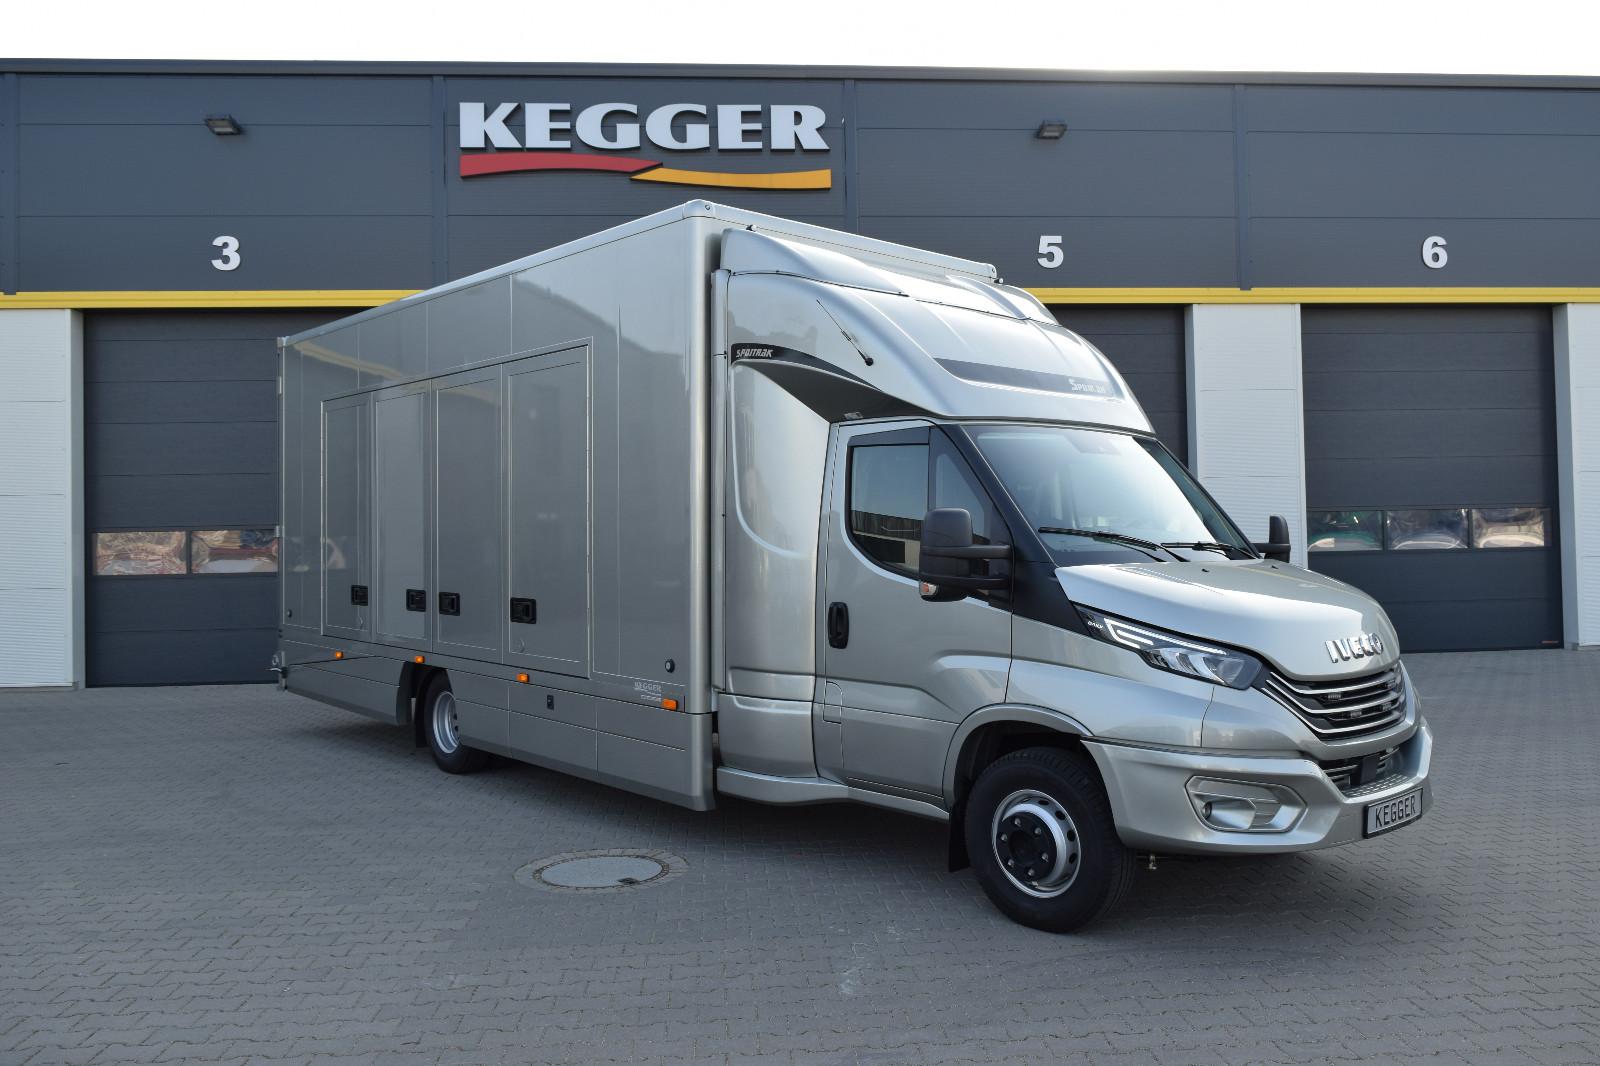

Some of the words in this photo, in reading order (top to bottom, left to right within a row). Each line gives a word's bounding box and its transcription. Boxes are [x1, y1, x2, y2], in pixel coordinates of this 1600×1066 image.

[459, 101, 830, 151] KEGGER
[211, 235, 241, 271] 3
[1037, 235, 1064, 269] 5
[1422, 235, 1448, 269] 6
[1325, 632, 1384, 664] IVECO
[1375, 795, 1416, 829] KEGGER
